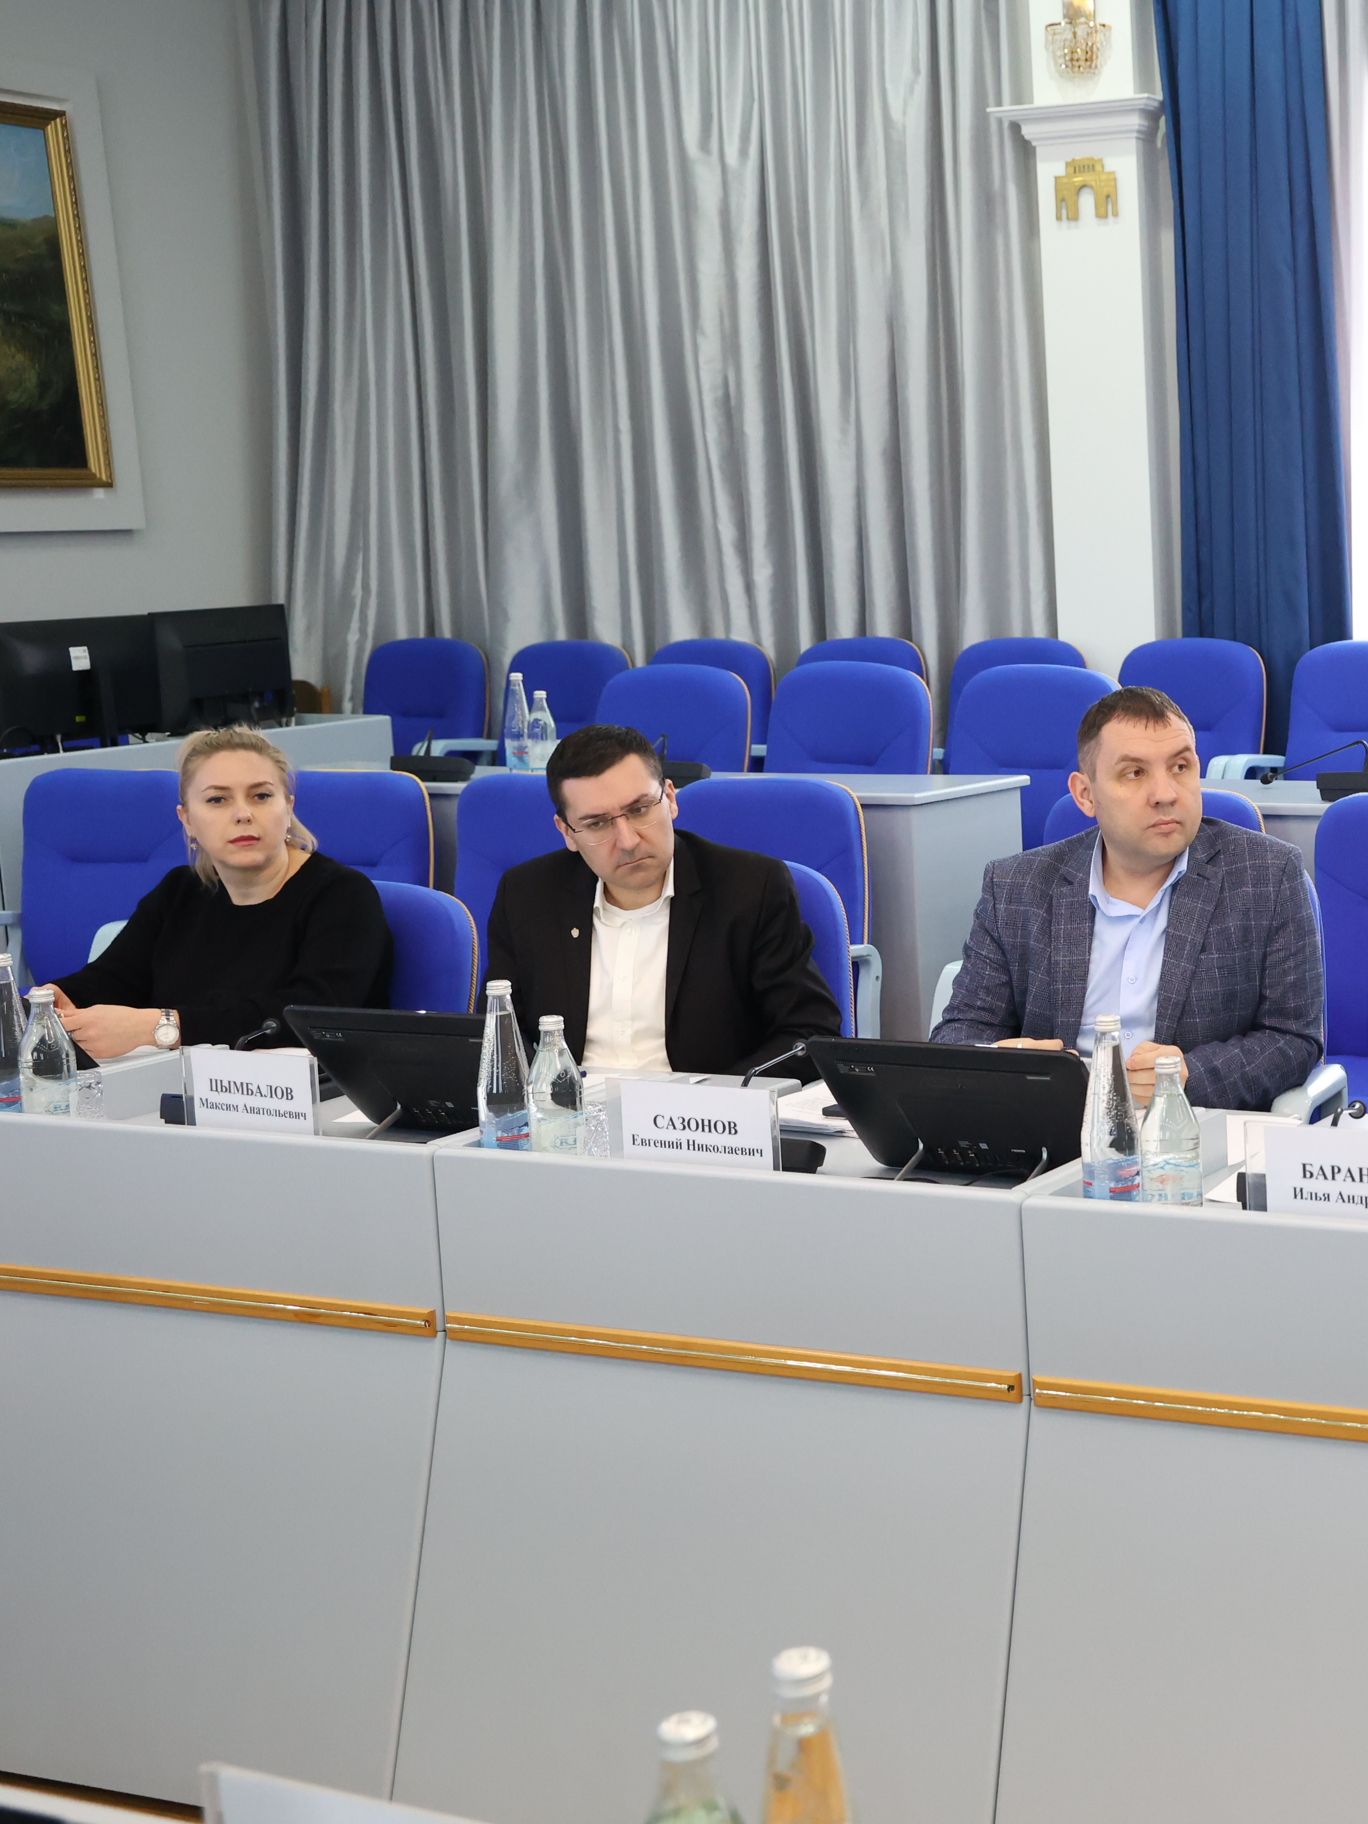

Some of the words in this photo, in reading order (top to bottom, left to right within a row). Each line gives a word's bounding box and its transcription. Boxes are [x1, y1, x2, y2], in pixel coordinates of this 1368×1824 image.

[208, 1078, 294, 1101] ЦЫМБАЛОВ
[199, 1097, 239, 1113] Максим
[241, 1103, 307, 1121] Анатольевич
[652, 1114, 739, 1136] САЗОНОВ
[631, 1134, 683, 1150] Евгений
[686, 1139, 764, 1157] Николаевич
[1293, 1187, 1331, 1202] Илья
